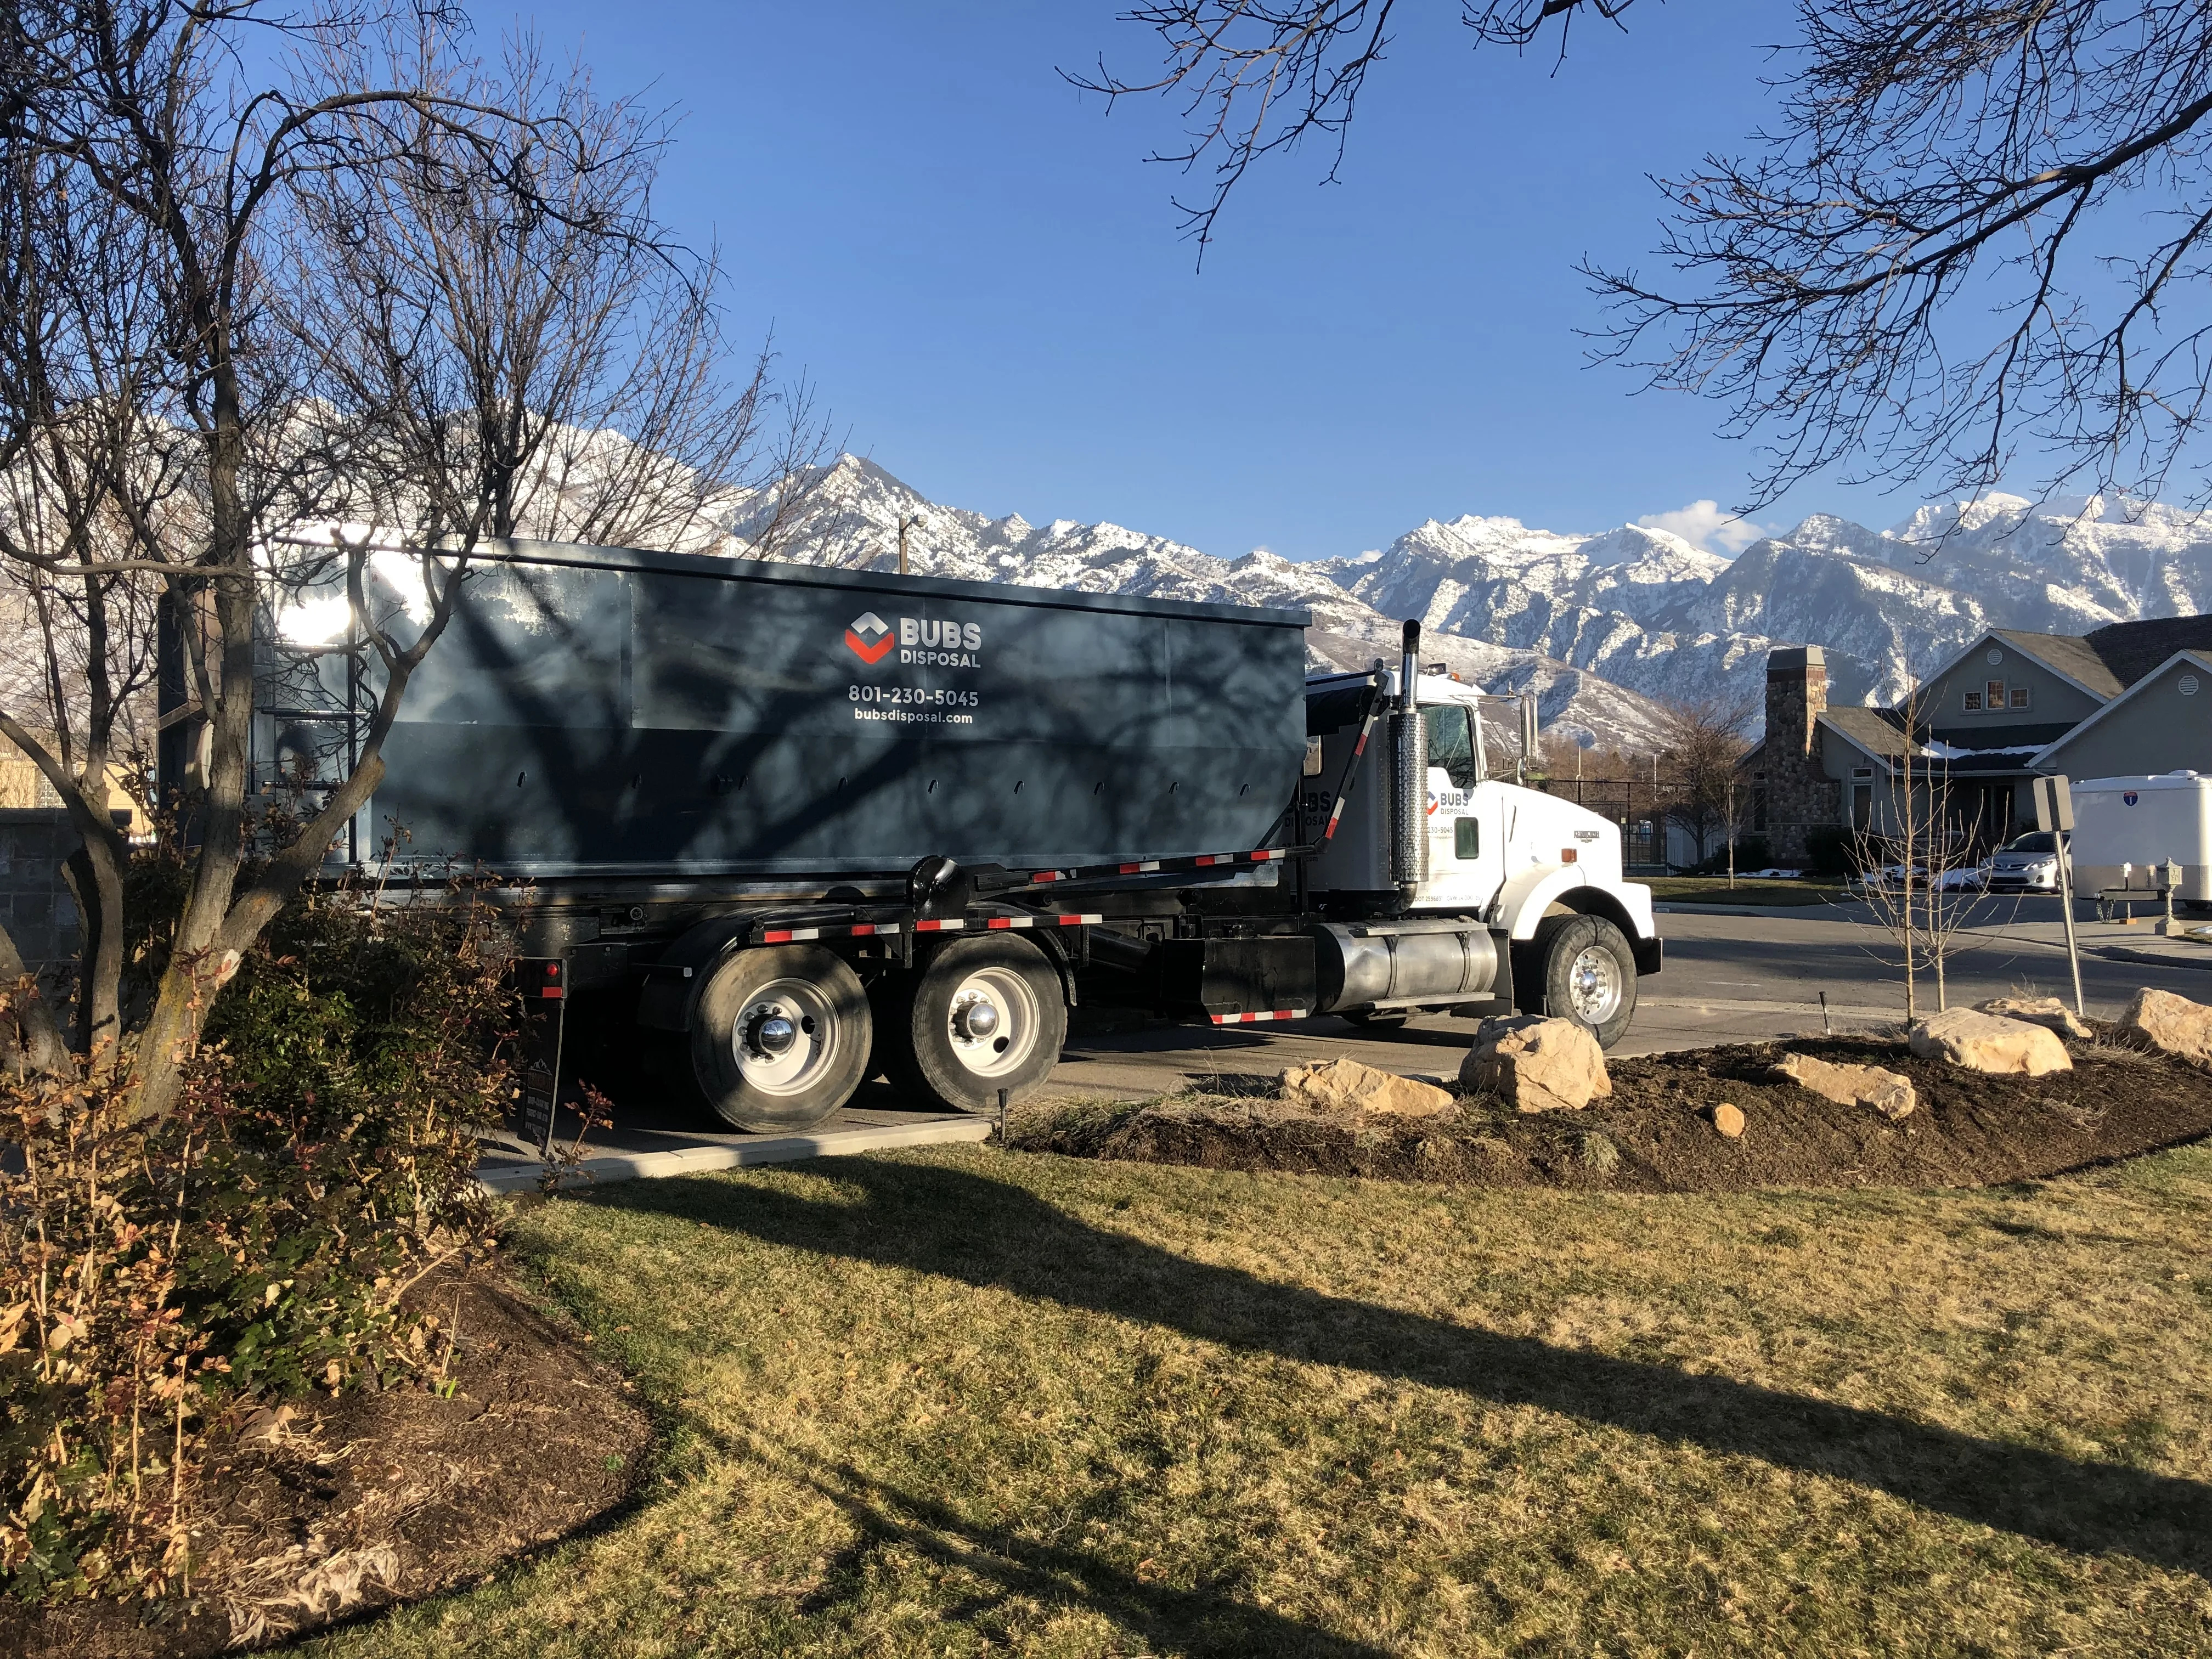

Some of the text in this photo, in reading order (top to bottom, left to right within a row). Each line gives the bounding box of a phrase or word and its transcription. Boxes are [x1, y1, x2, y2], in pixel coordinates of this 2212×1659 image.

[900, 617, 981, 651] BUBS
[901, 650, 981, 668] DISPOSAL
[848, 685, 979, 707] 801-230-5045
[855, 707, 973, 724] bubsdisposal.com
[1440, 793, 1469, 806] BUBS
[1285, 815, 1328, 827] DIOSA
